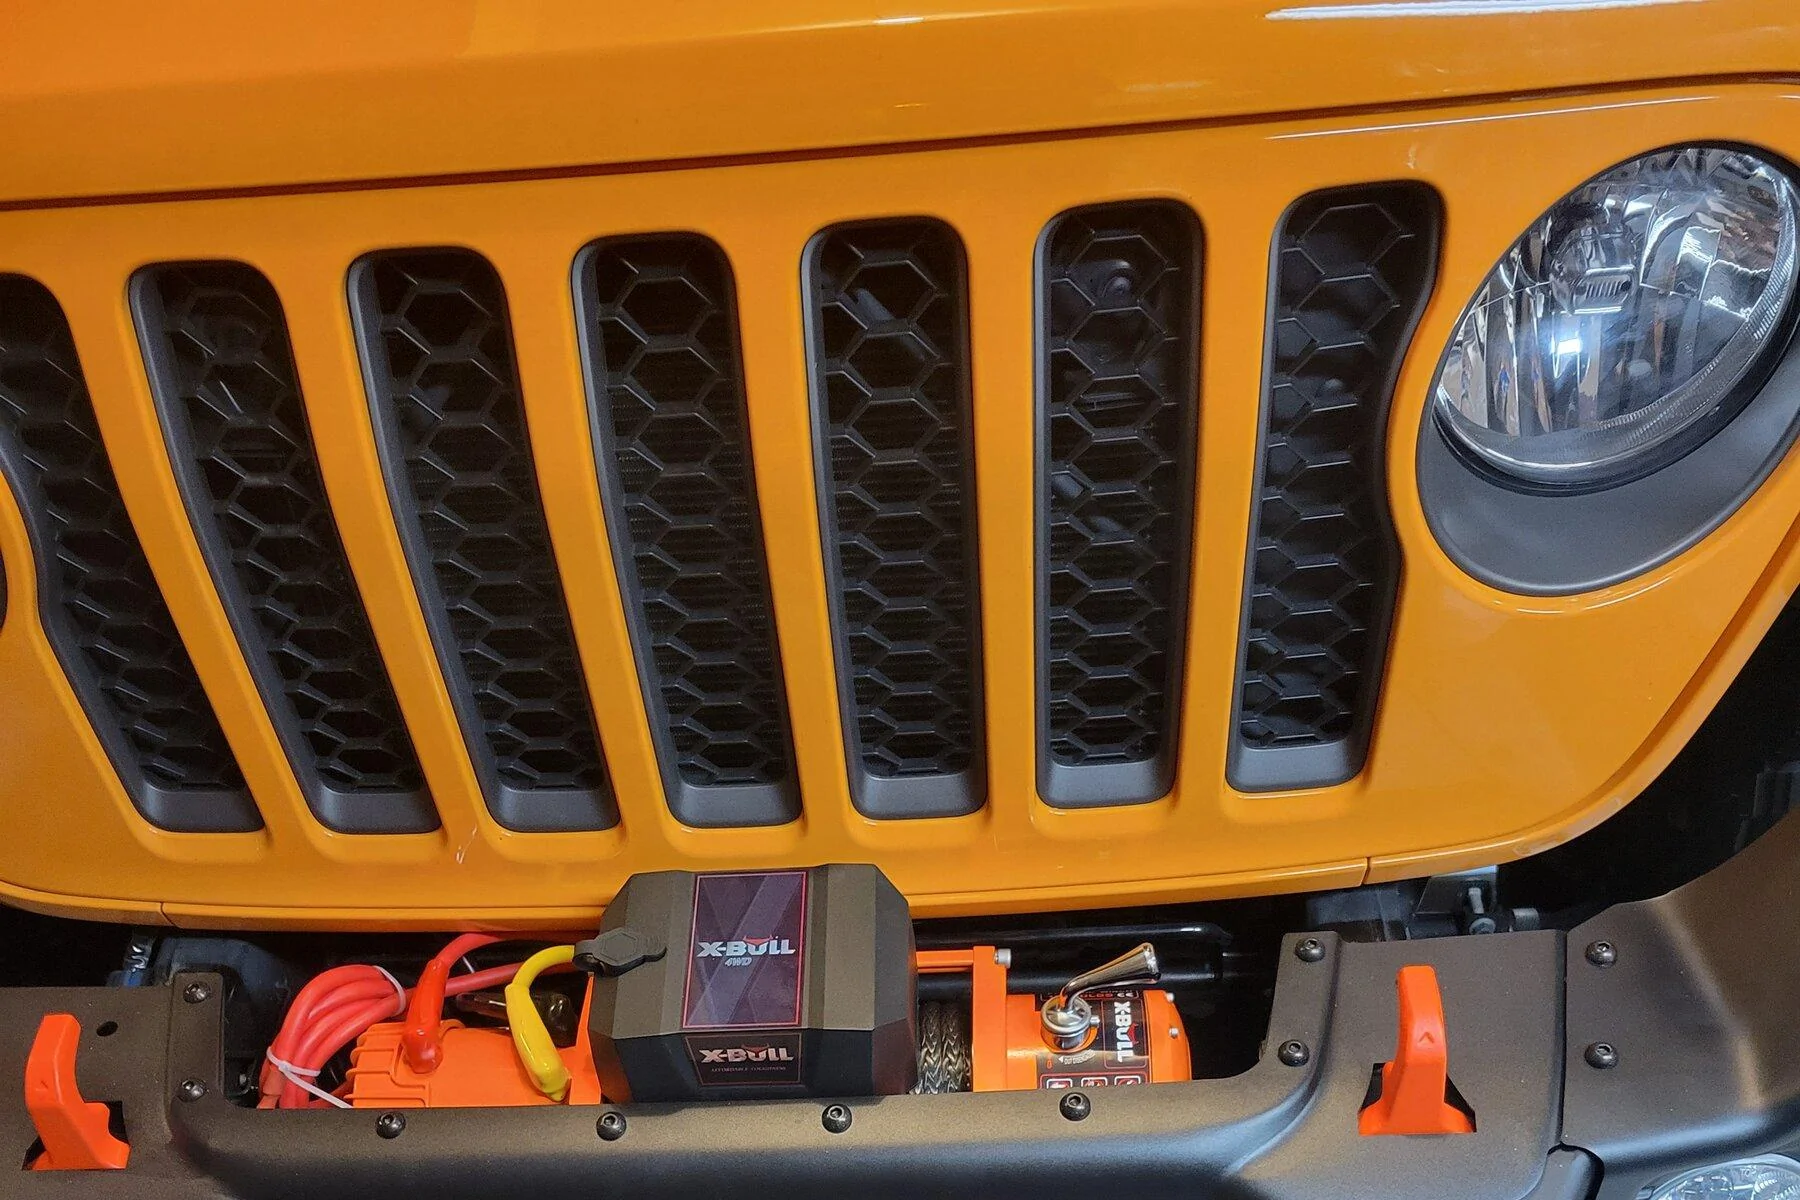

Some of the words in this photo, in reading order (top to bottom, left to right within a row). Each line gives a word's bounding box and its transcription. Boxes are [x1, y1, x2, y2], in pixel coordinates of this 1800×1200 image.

[696, 936, 796, 958] X-BULL
[1113, 1001, 1135, 1063] X-BULL
[700, 1046, 795, 1063] X-BULL
